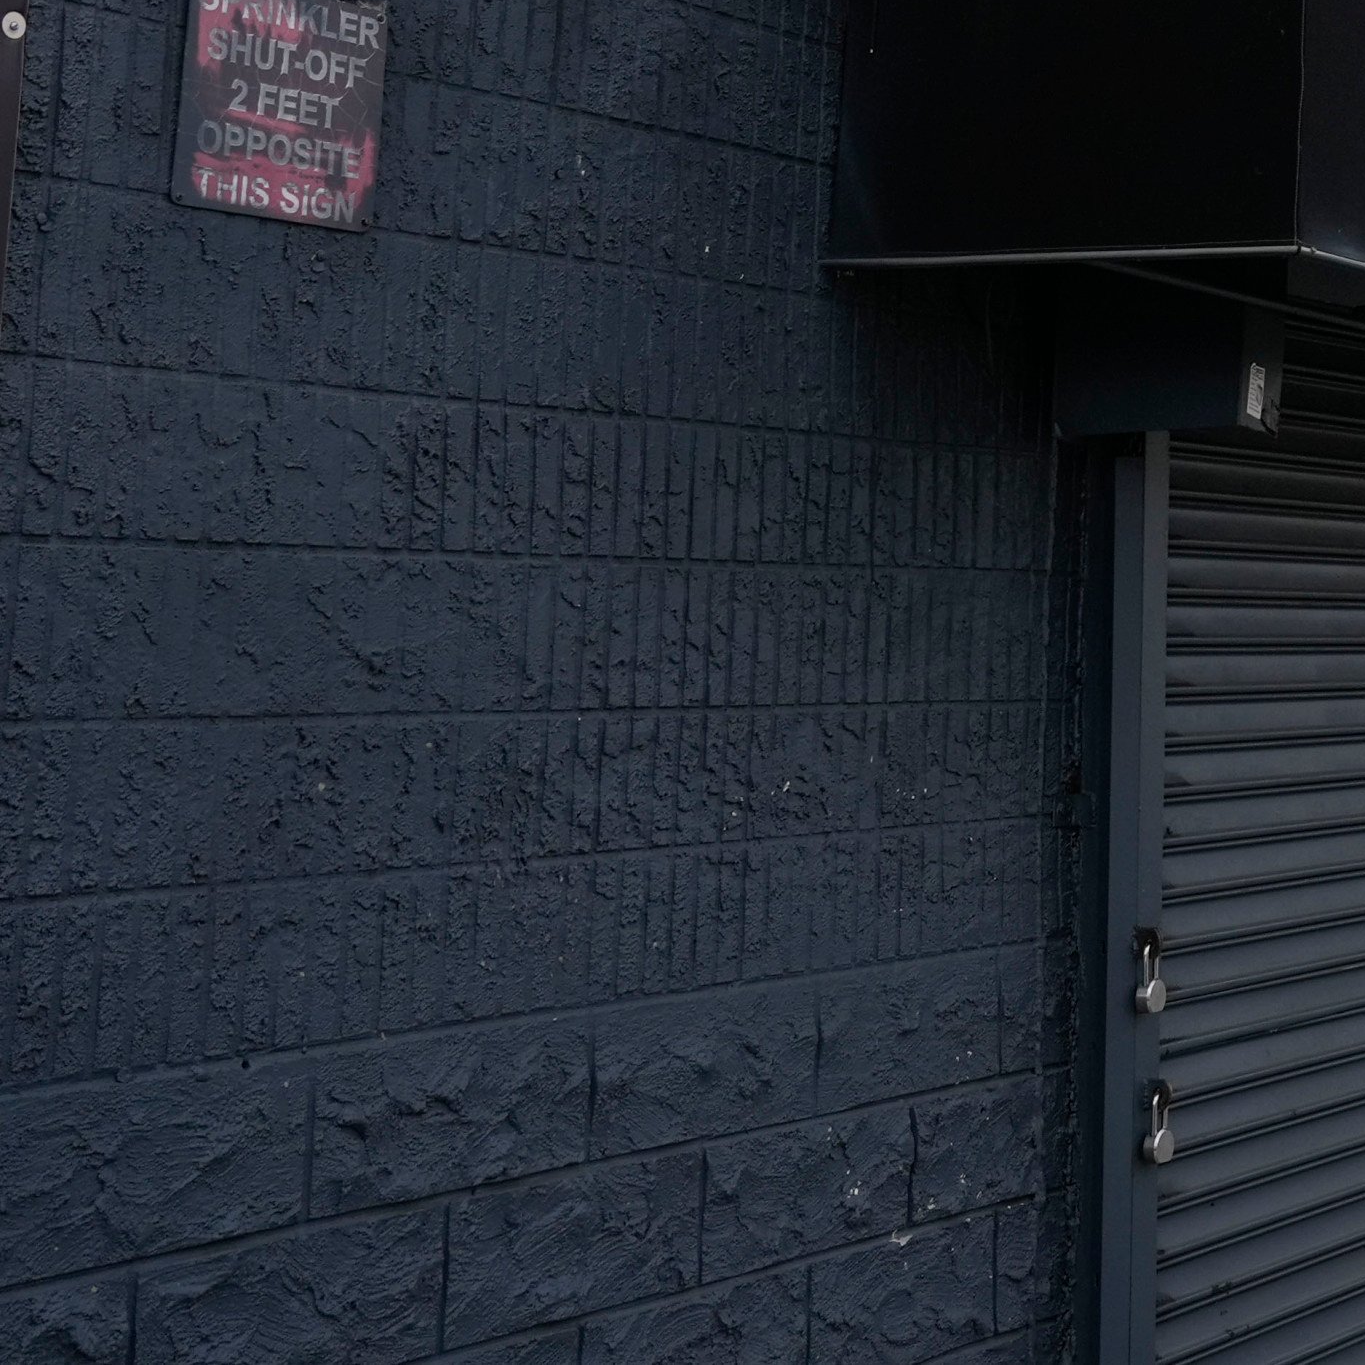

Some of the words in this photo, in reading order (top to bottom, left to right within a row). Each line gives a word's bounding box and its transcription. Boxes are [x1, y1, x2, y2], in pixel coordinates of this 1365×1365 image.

[207, 27, 367, 88] SHUT-OFF
[228, 78, 249, 113] 2
[256, 83, 340, 129] FEET
[197, 119, 361, 179] OPPOSITE
[197, 167, 270, 210] THIS
[279, 182, 356, 224] SIGN
